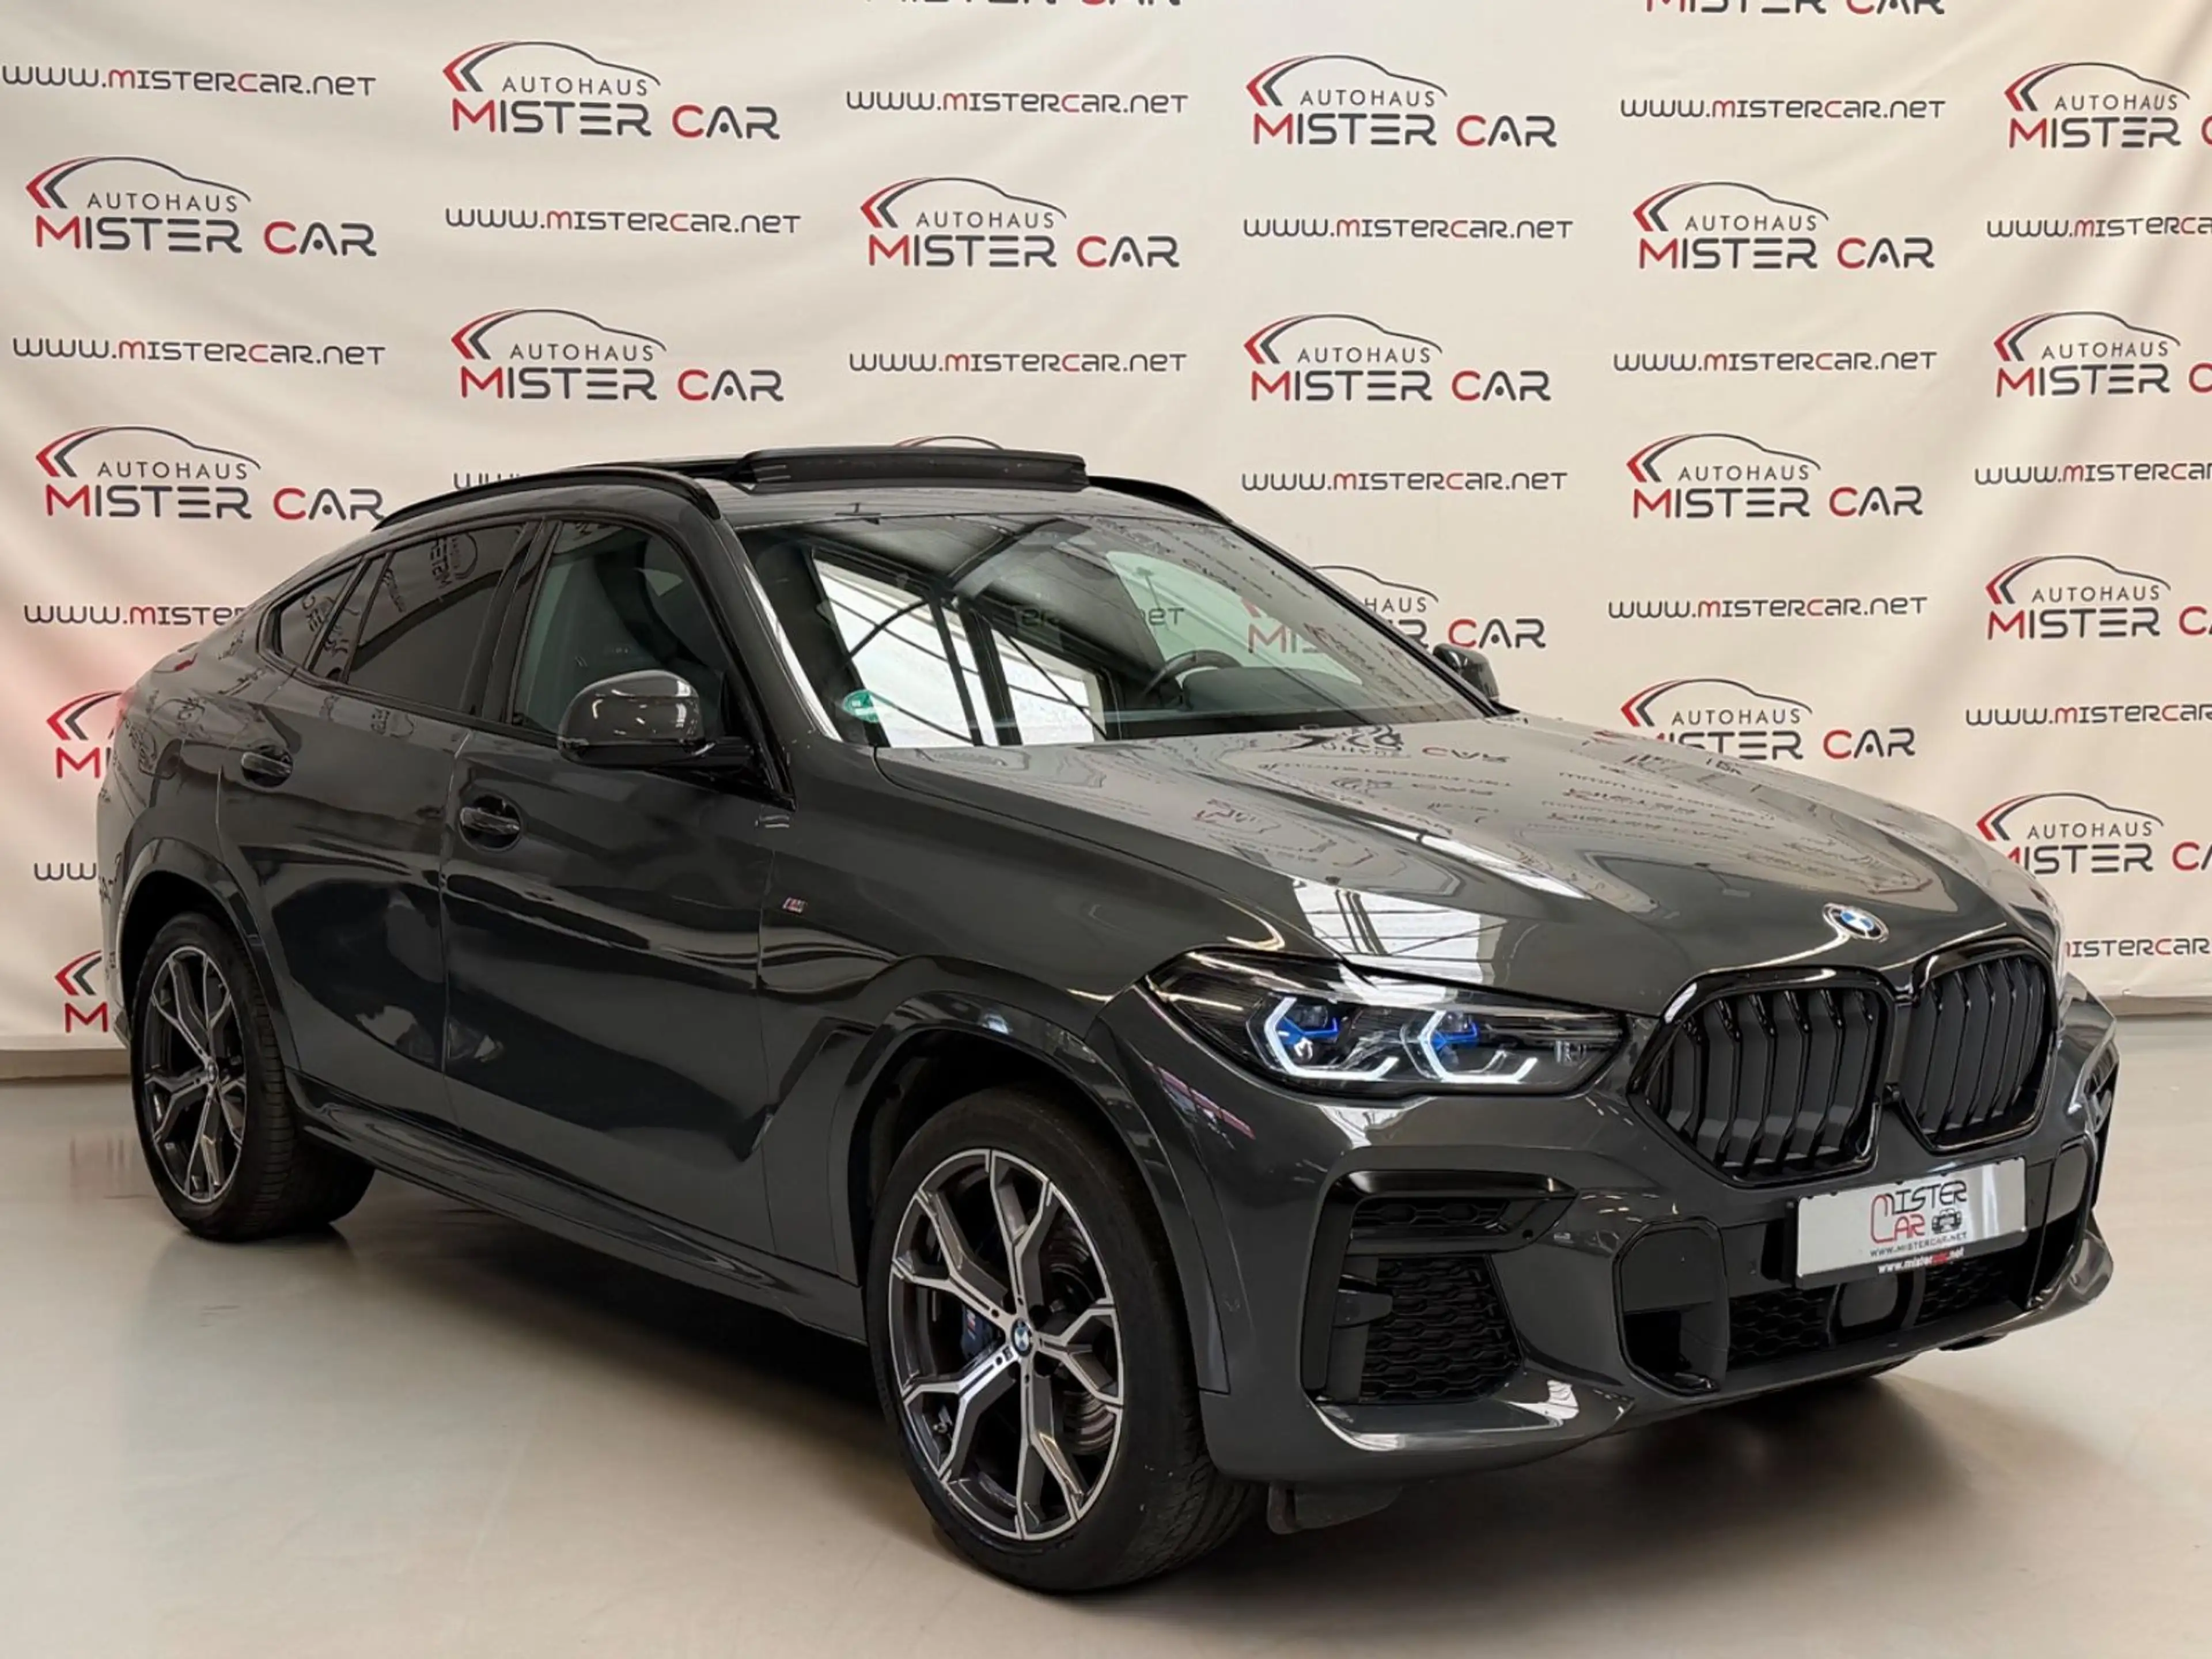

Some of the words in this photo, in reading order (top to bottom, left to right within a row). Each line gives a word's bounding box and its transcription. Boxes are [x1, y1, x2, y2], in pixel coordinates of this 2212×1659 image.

[502, 77, 647, 96] AUTOHAUS
[1300, 89, 1434, 107] AUTOHAUS
[2055, 94, 2177, 111] AUTOHAUS
[452, 98, 652, 137] MISTER
[672, 105, 780, 140] CAR
[1253, 112, 1437, 146] MISTER
[1456, 115, 1557, 147] CAR
[2009, 116, 2181, 149] MISTER
[87, 192, 237, 213] AUTOHAUS
[36, 215, 243, 253] MISTER
[264, 221, 377, 256] CAR
[916, 211, 1054, 229] AUTOHAUS
[1685, 215, 1816, 232] AUTOHAUS
[869, 234, 1057, 268] MISTER
[1077, 236, 1180, 268] CAR
[1639, 237, 1818, 269] MISTER
[1837, 237, 1935, 269] CAR
[510, 343, 653, 362] AUTOHAUS
[1297, 347, 1430, 363] AUTOHAUS
[2041, 340, 2168, 359] AUTOHAUS
[461, 366, 657, 400] MISTER
[677, 369, 784, 402] CAR
[1252, 370, 1433, 401] MISTER
[1452, 370, 1551, 402] CAR
[1997, 363, 2171, 397] MISTER
[97, 461, 247, 480] AUTOHAUS
[1678, 464, 1809, 482] AUTOHAUS
[46, 484, 252, 520] MISTER
[273, 488, 384, 520] CAR
[1633, 487, 1810, 519] MISTER
[1830, 486, 1923, 517] CAR
[2031, 585, 2159, 603] AUTOHAUS
[1448, 618, 1546, 649] CAR
[1988, 607, 2160, 640] MISTER
[1672, 708, 1800, 726] AUTOHAUS
[1657, 730, 1804, 760] STER
[1823, 728, 1915, 759] CAR
[2027, 821, 2152, 839] AUTOHAUS
[1872, 1180, 1967, 1215] MISTER
[1870, 1201, 1925, 1244] CAR
